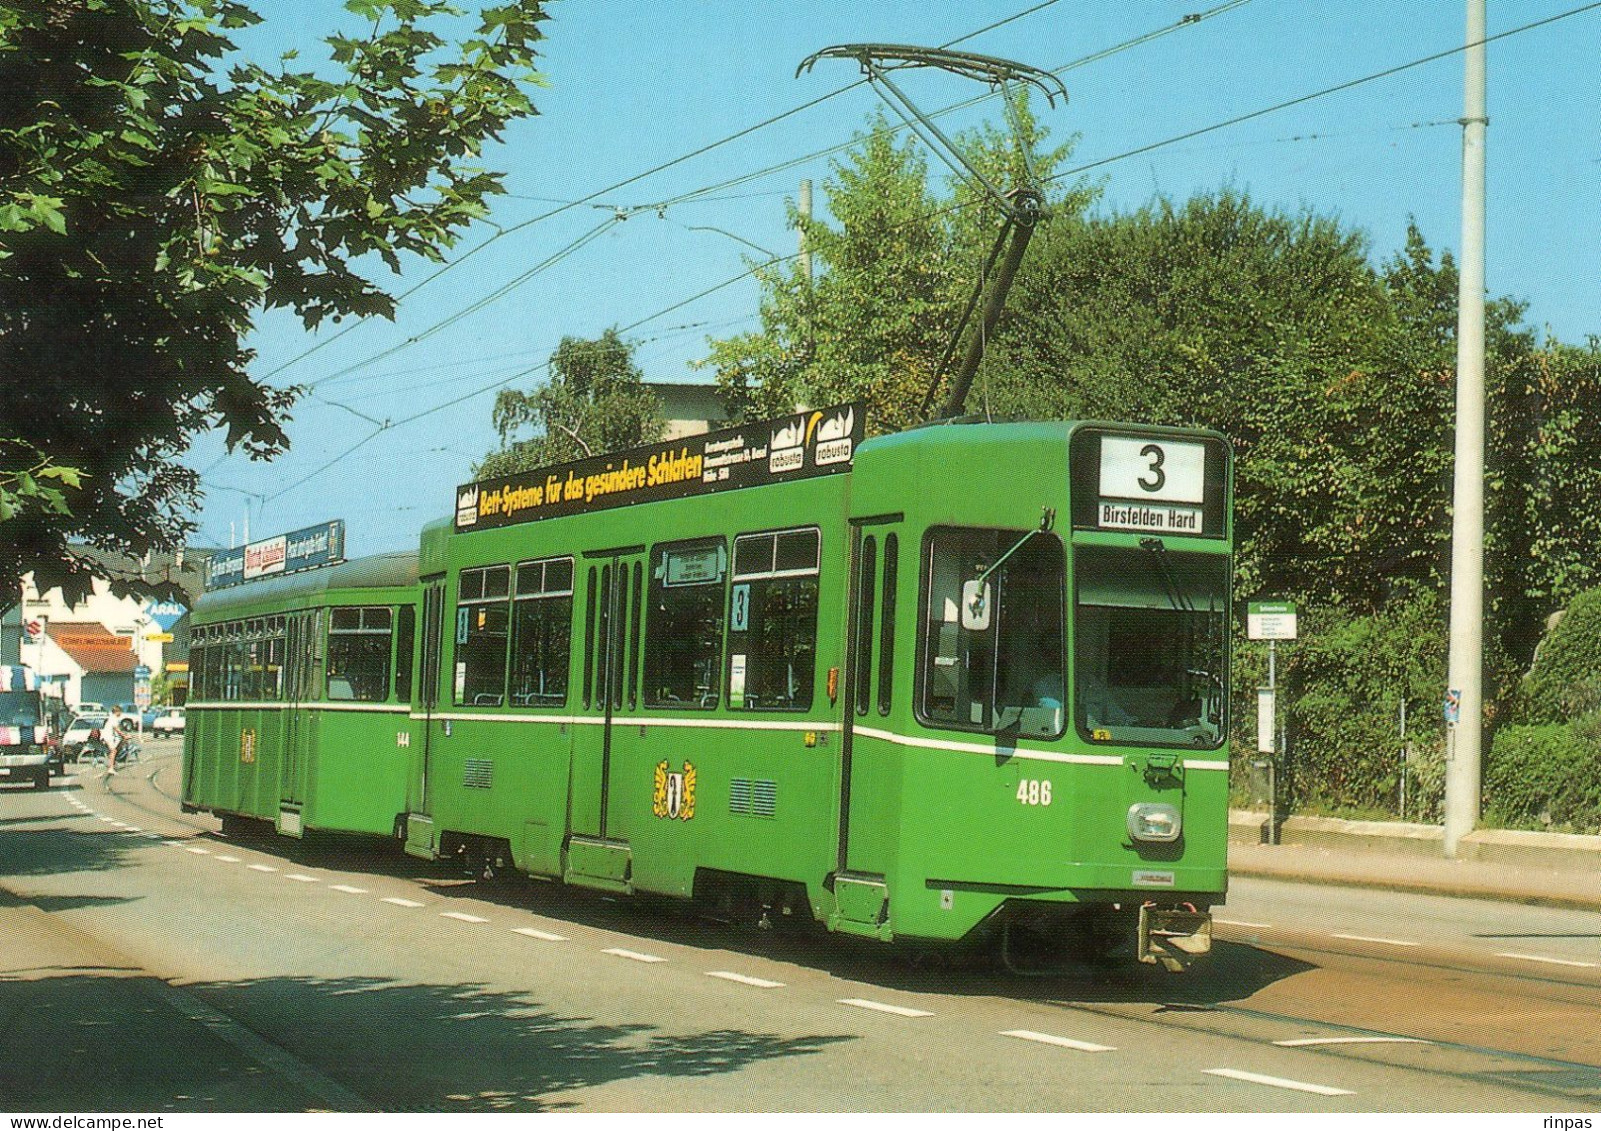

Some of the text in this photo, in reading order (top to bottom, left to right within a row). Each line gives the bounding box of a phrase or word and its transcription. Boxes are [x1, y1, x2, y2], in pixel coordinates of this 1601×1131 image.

[817, 442, 850, 461] robusta
[1137, 444, 1166, 493] 3
[479, 484, 543, 517] Bett-Systeme
[545, 475, 562, 503] für
[564, 470, 584, 501] das
[585, 460, 645, 502] gesündere
[646, 448, 702, 487] Schlafen
[1103, 505, 1196, 529] Birsfelden Hard
[150, 602, 181, 616] ARAL
[736, 590, 745, 626] 3
[1016, 779, 1052, 806] 486
